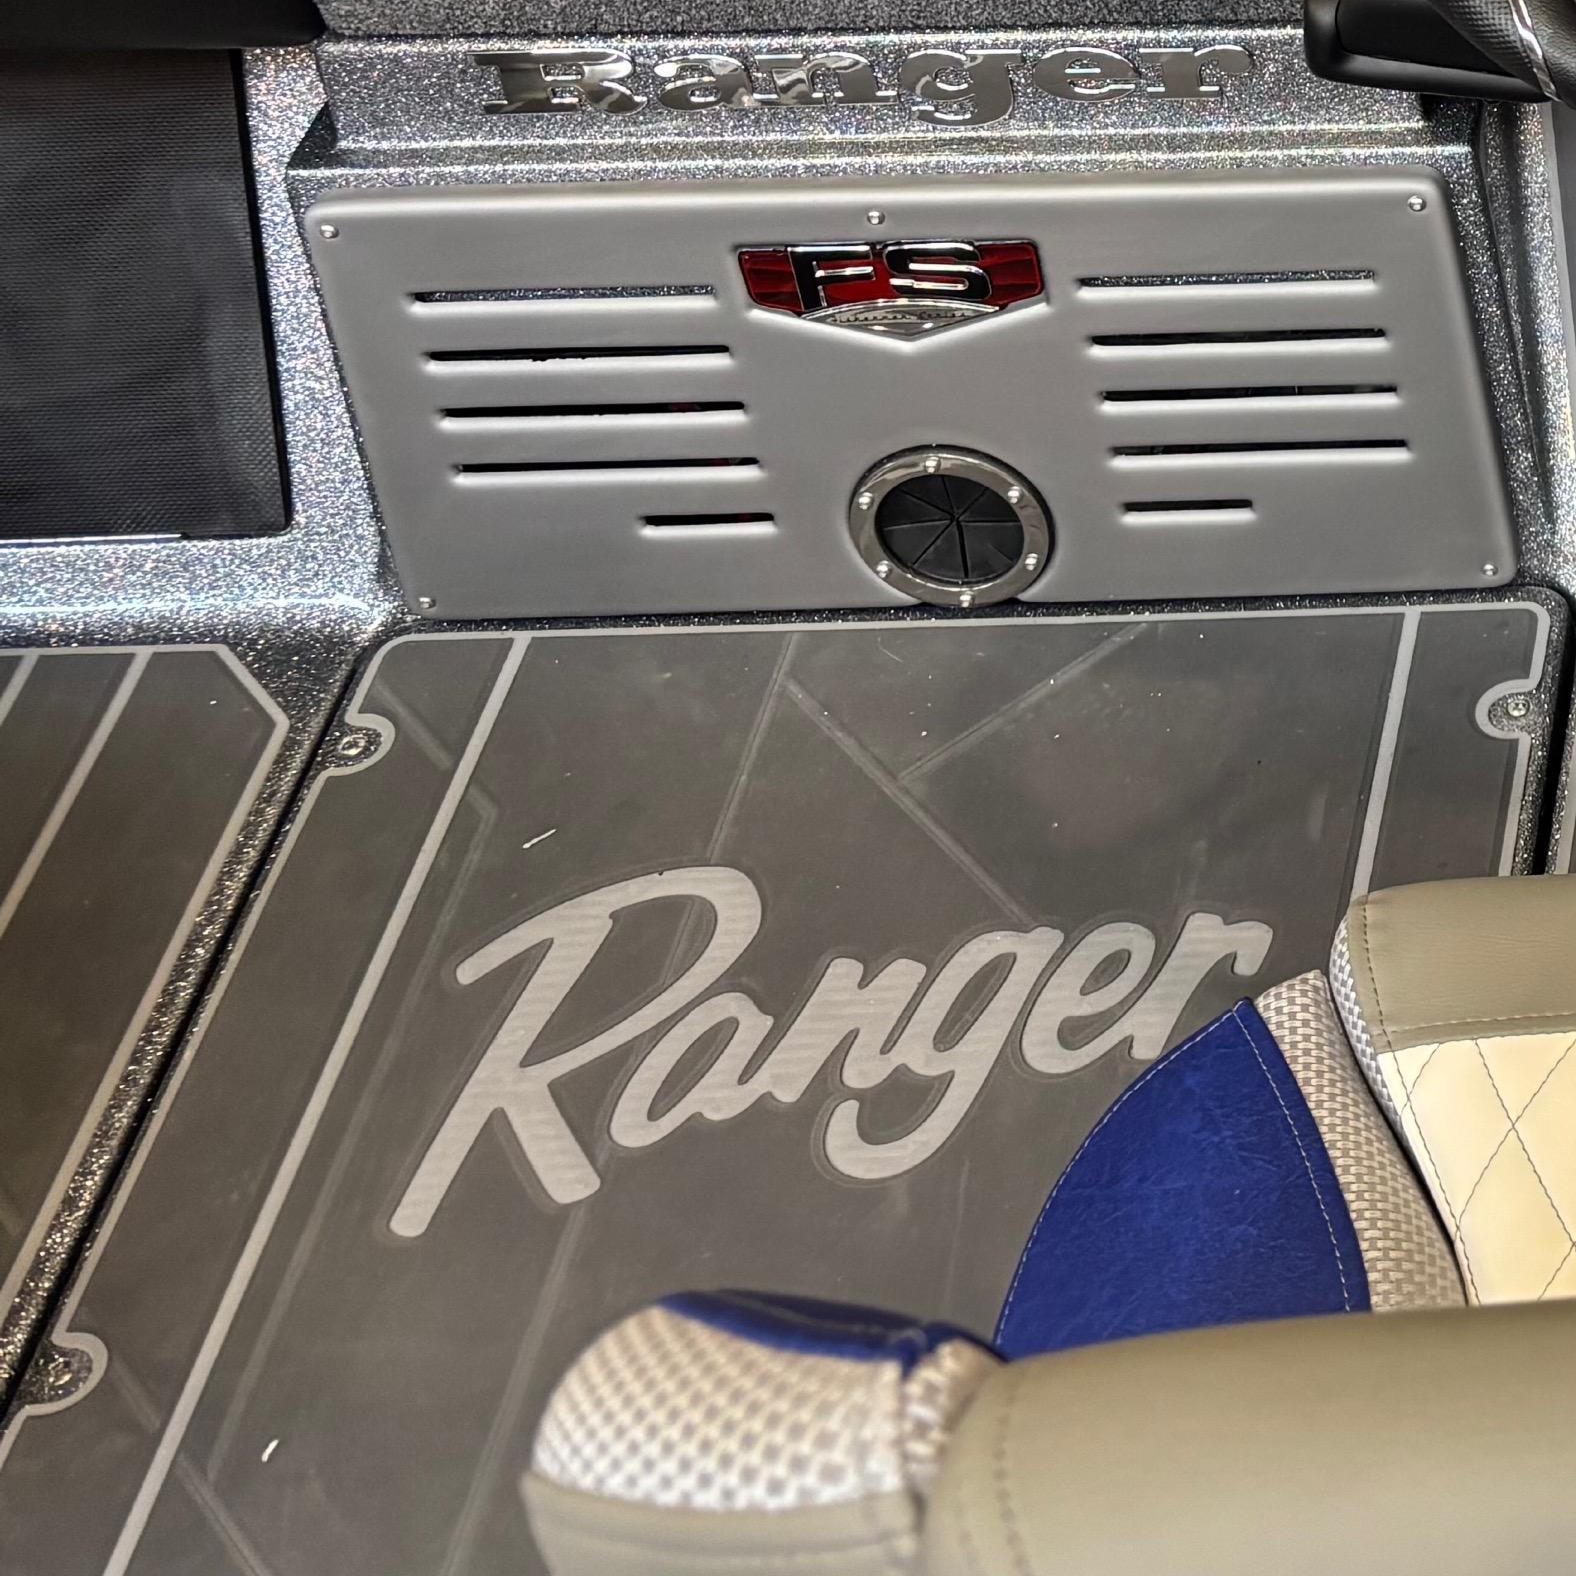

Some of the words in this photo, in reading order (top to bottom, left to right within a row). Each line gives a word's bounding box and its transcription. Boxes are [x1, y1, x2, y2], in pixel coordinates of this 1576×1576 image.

[467, 44, 1256, 128] Ranger
[786, 241, 994, 312] FS
[389, 864, 1274, 1238] Ranger
